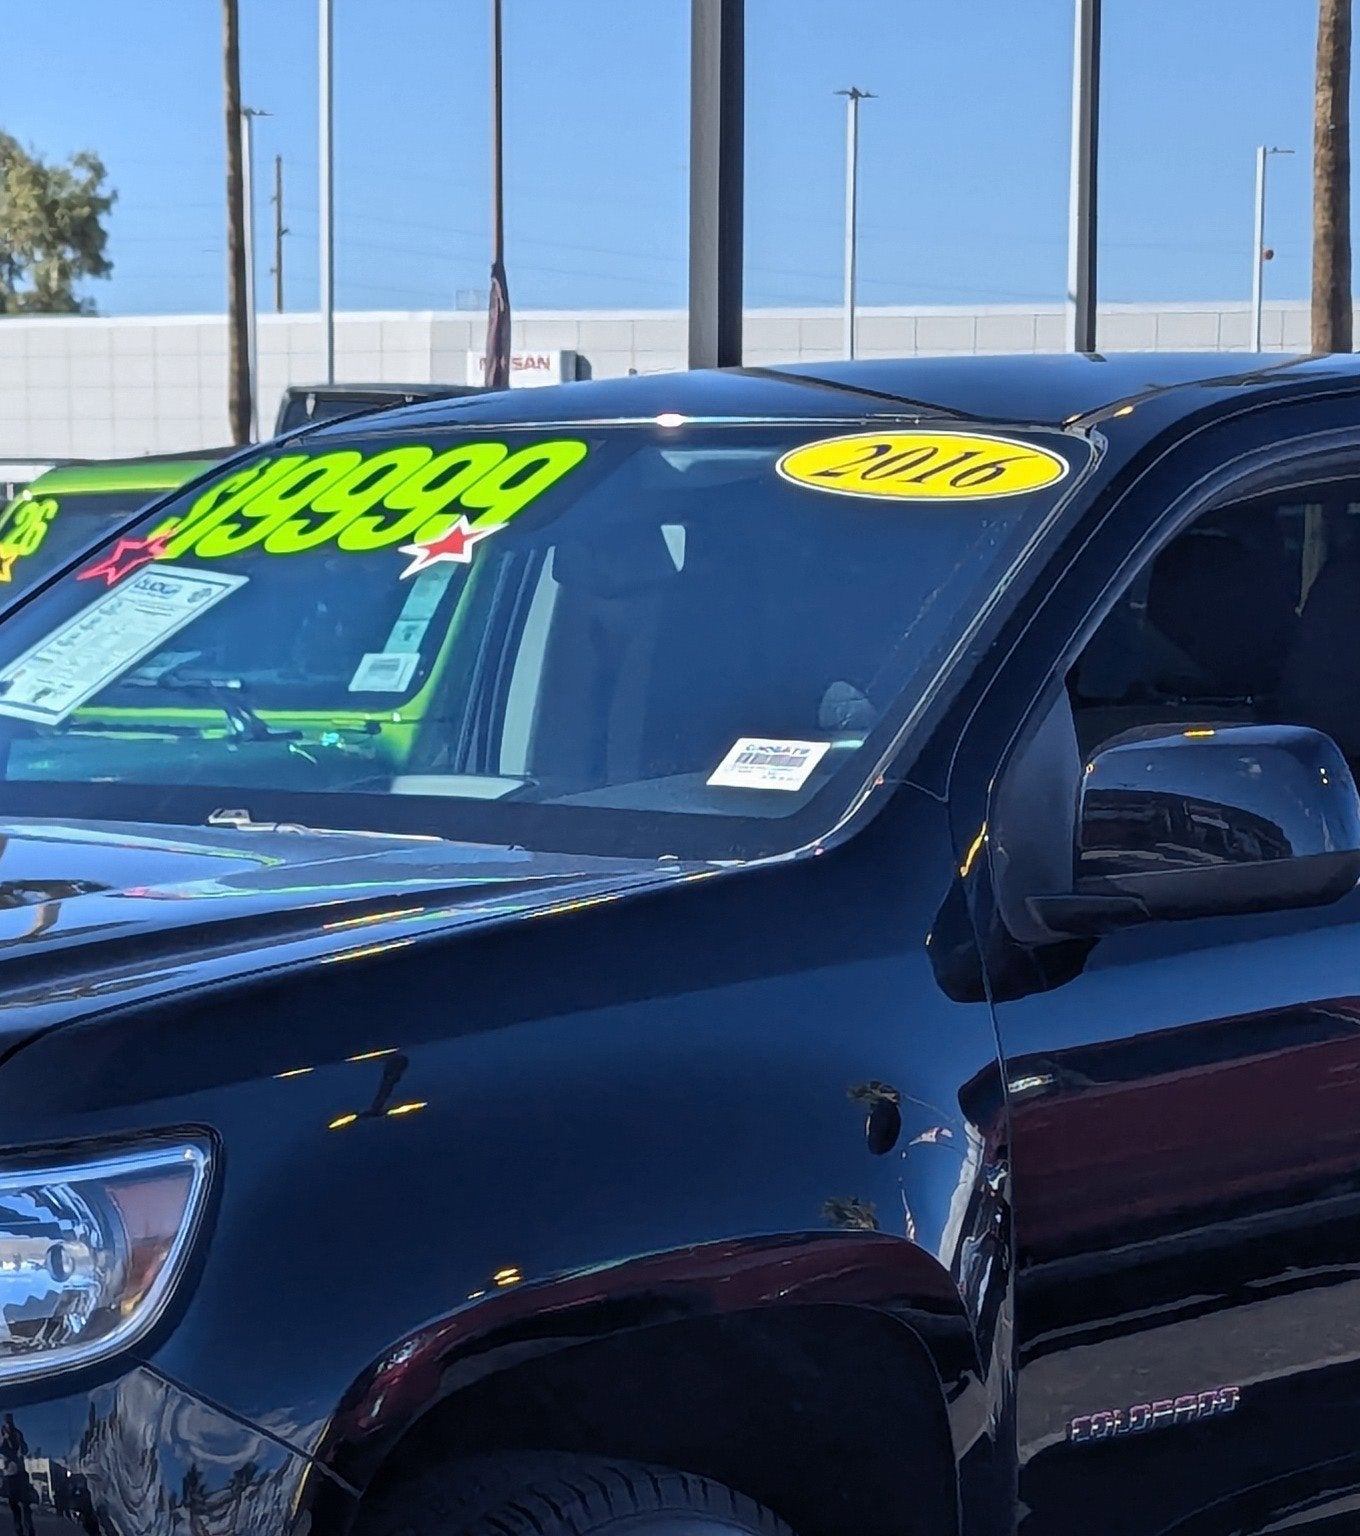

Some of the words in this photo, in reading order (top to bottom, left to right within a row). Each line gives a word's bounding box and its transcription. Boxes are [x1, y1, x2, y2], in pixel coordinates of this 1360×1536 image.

[478, 356, 551, 371] NSAN
[808, 443, 1039, 488] 2016
[148, 440, 588, 559] $19999
[1071, 1386, 1240, 1442] COLORADO
